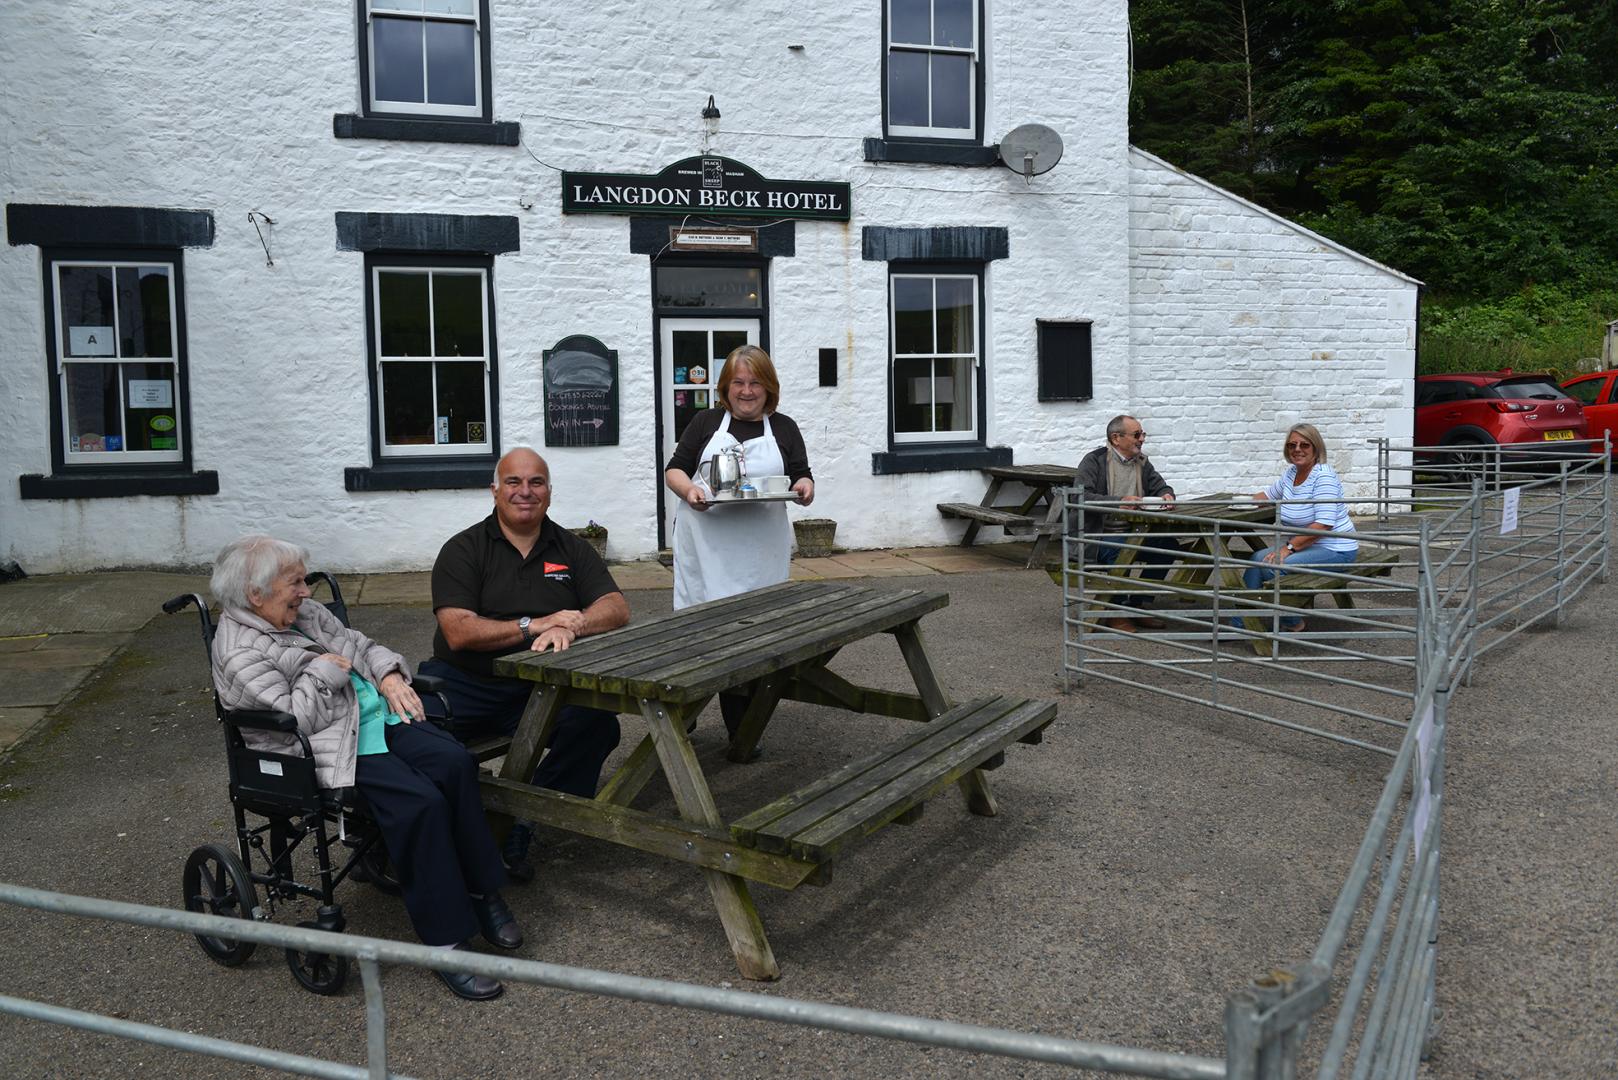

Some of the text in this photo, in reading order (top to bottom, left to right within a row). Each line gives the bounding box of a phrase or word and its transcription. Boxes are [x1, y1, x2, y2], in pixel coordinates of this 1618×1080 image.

[573, 185, 842, 211] LANGDON BECK HOTEL
[87, 334, 98, 345] A
[549, 416, 582, 430] WAY IN
